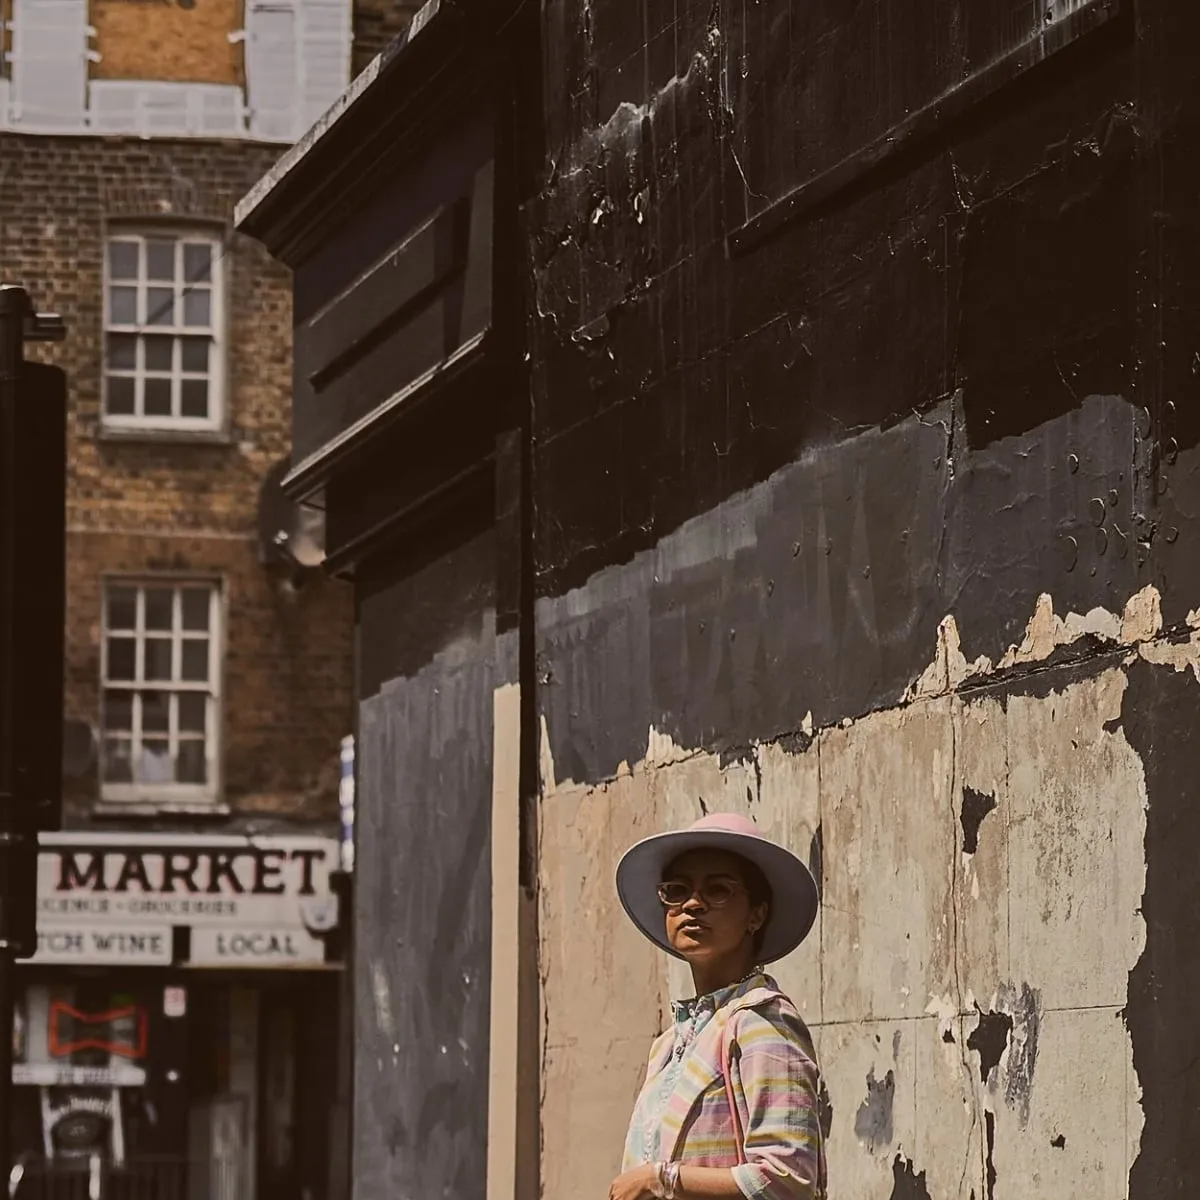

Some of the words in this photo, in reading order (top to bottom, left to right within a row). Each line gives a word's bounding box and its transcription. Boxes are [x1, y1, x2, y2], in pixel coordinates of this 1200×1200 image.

[55, 848, 326, 895] MARKET
[91, 932, 164, 955] WINE
[216, 933, 298, 957] LOCAL
